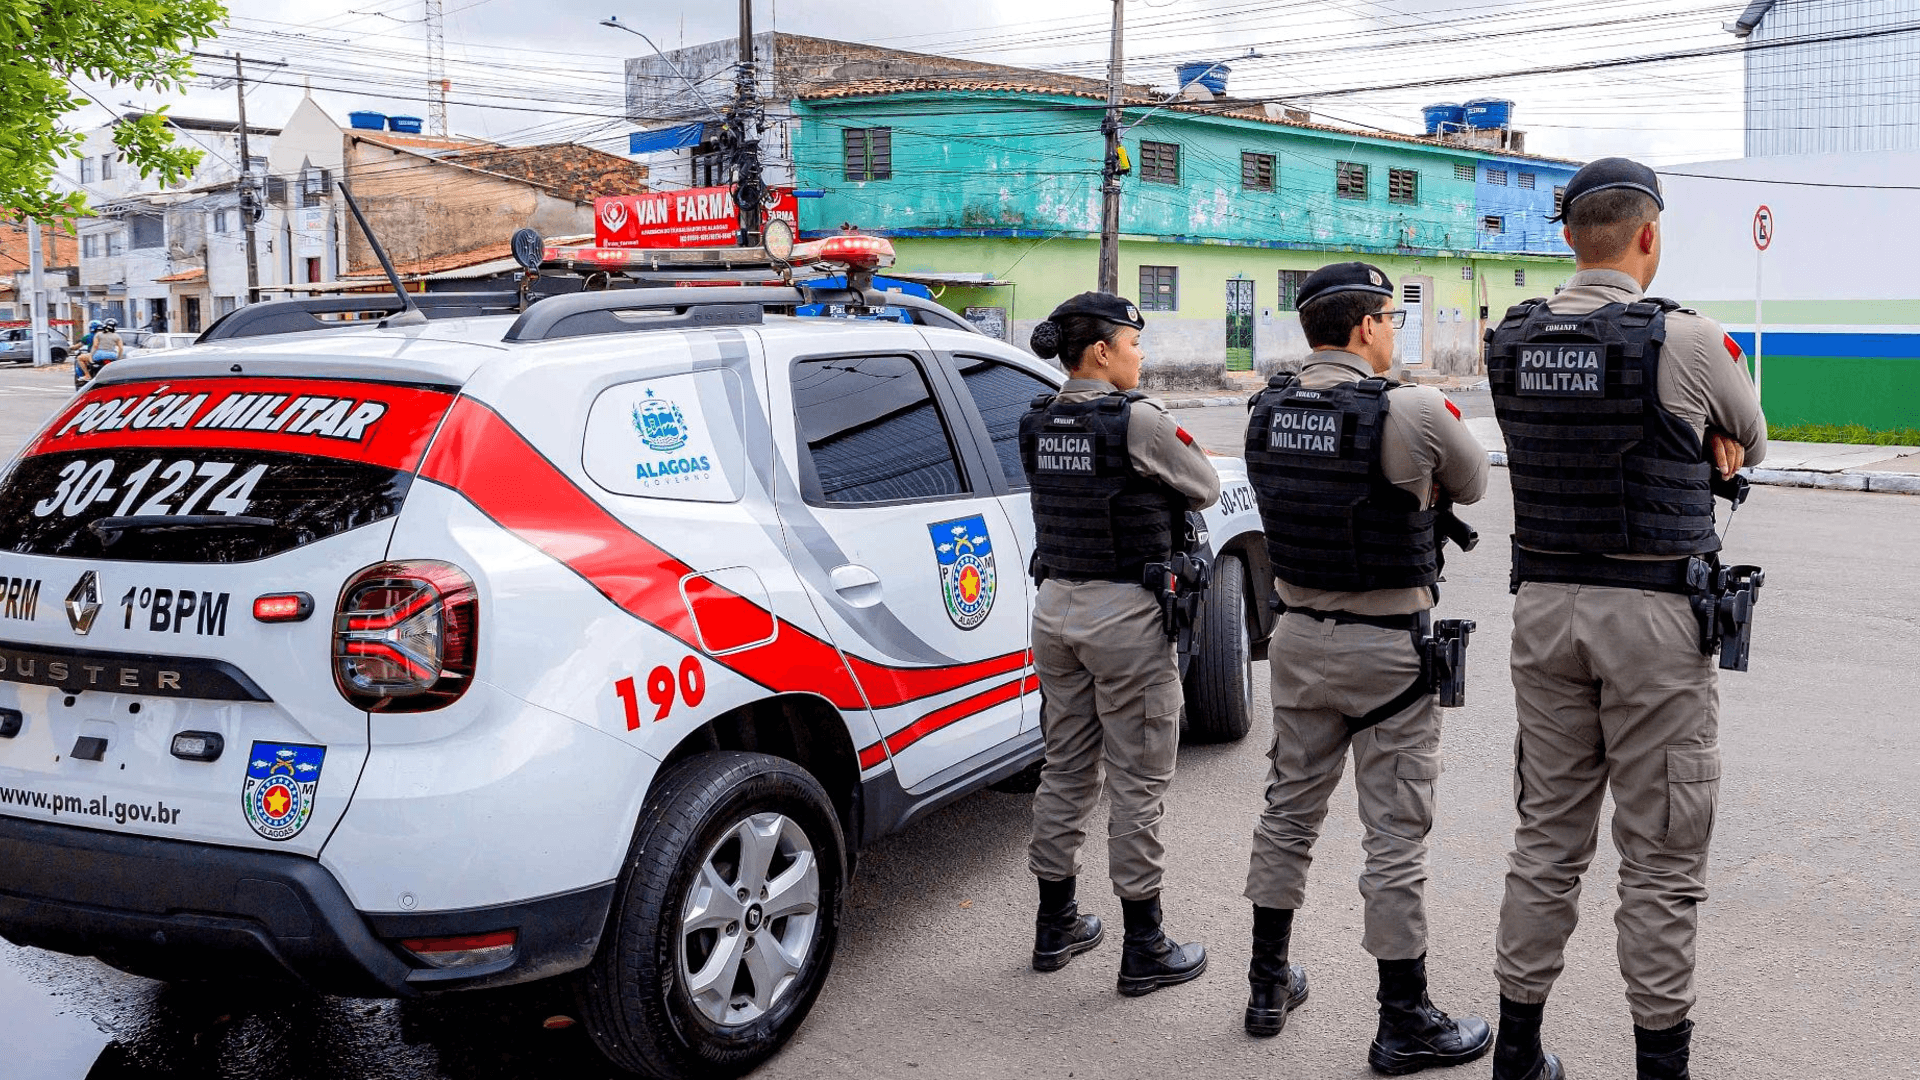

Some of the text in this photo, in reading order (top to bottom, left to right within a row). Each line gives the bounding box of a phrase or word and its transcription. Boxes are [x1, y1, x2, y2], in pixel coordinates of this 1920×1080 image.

[635, 192, 735, 225] VAN FARMA
[1521, 346, 1599, 369] POLÍCIA
[1520, 372, 1599, 391] MILITAR
[56, 384, 387, 441] POLÍCIA MILITAR
[1272, 410, 1337, 432] POLÍCIA
[1038, 435, 1091, 453] POLÍCIA
[1271, 432, 1335, 452] MILITAR
[636, 455, 710, 480] ALAGOAS
[1037, 455, 1092, 471] MILITAR
[34, 459, 269, 517] 30-1274
[643, 473, 710, 488] GOVERNO
[942, 556, 993, 580] P M
[958, 609, 986, 626] ALAGOAS
[615, 655, 706, 732] 190
[246, 780, 314, 795] P M
[0, 786, 181, 825] www.pm.al.gov.br
[258, 825, 294, 838] ALAGOAS
